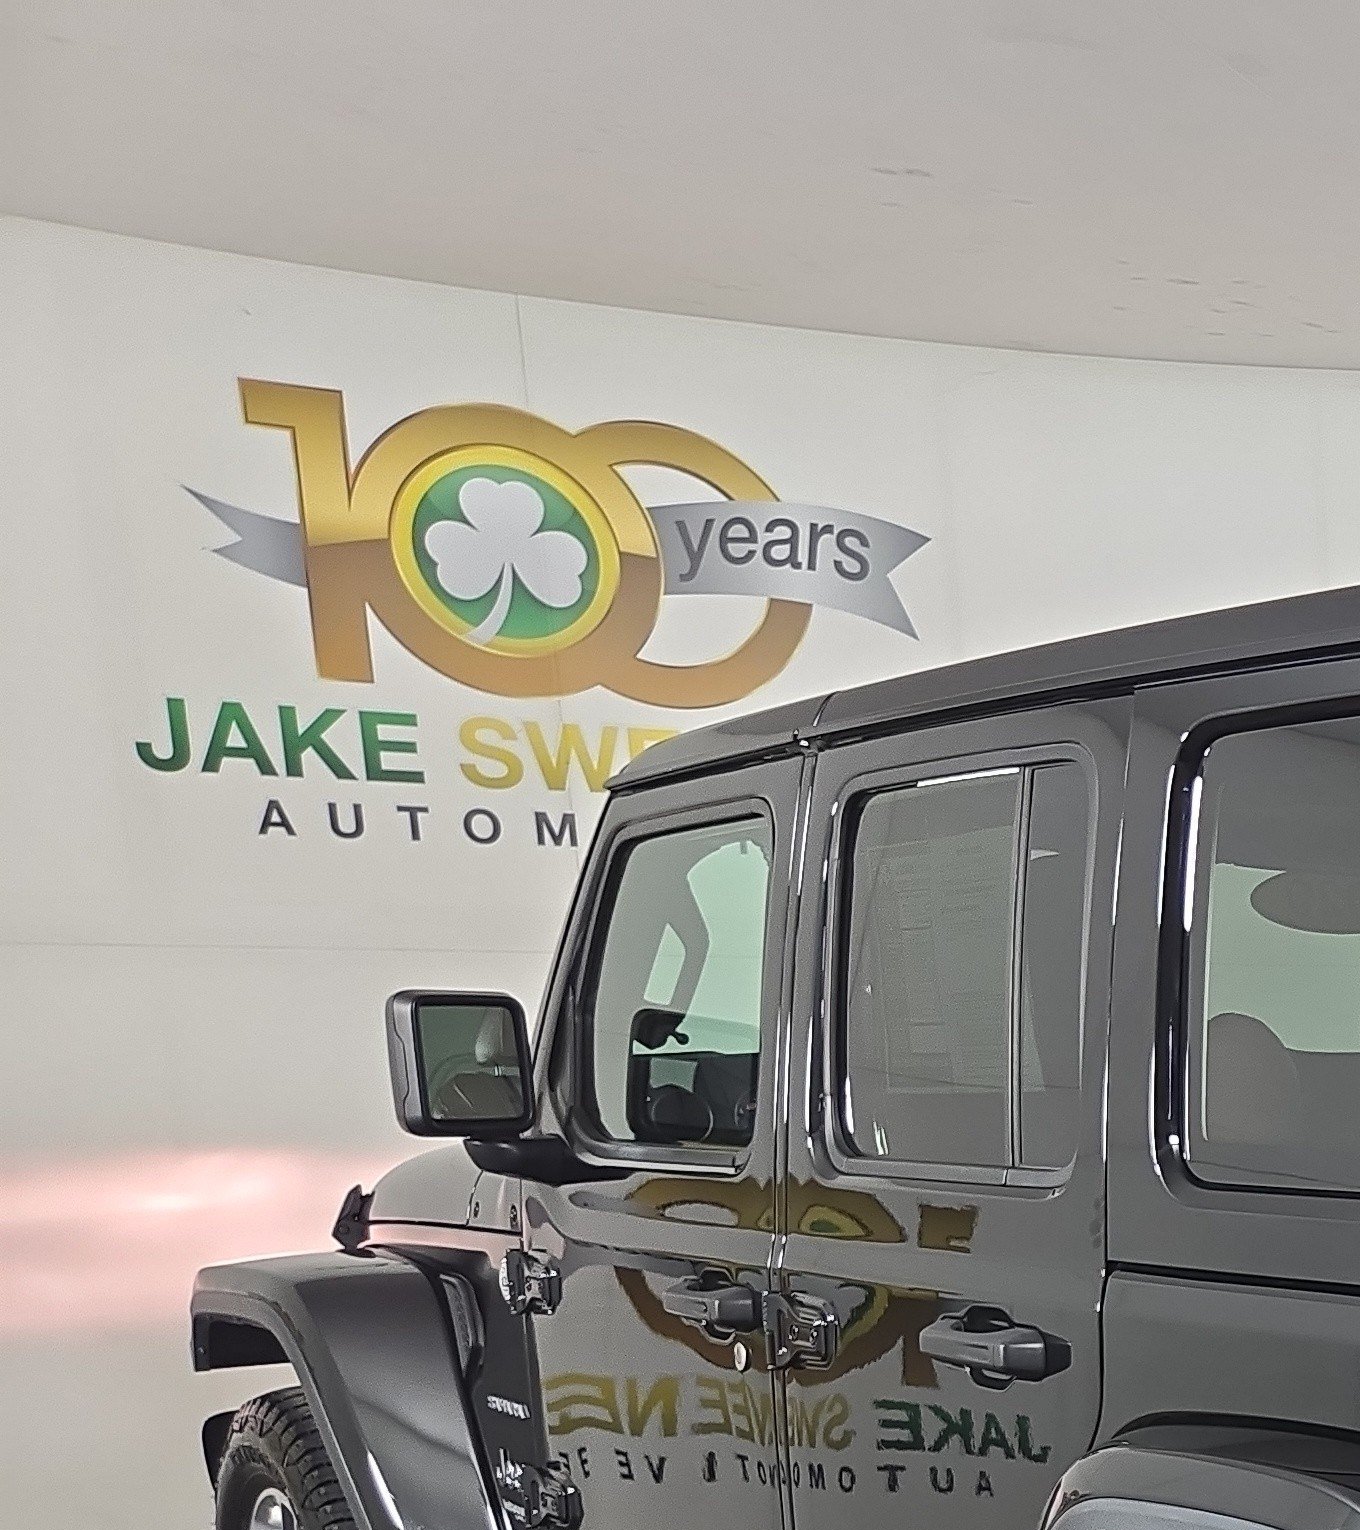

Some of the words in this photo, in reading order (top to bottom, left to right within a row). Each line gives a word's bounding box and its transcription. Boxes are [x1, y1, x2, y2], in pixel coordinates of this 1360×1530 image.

[676, 513, 872, 583] years
[135, 697, 426, 786] JAKE
[258, 799, 579, 849] AUTOM
